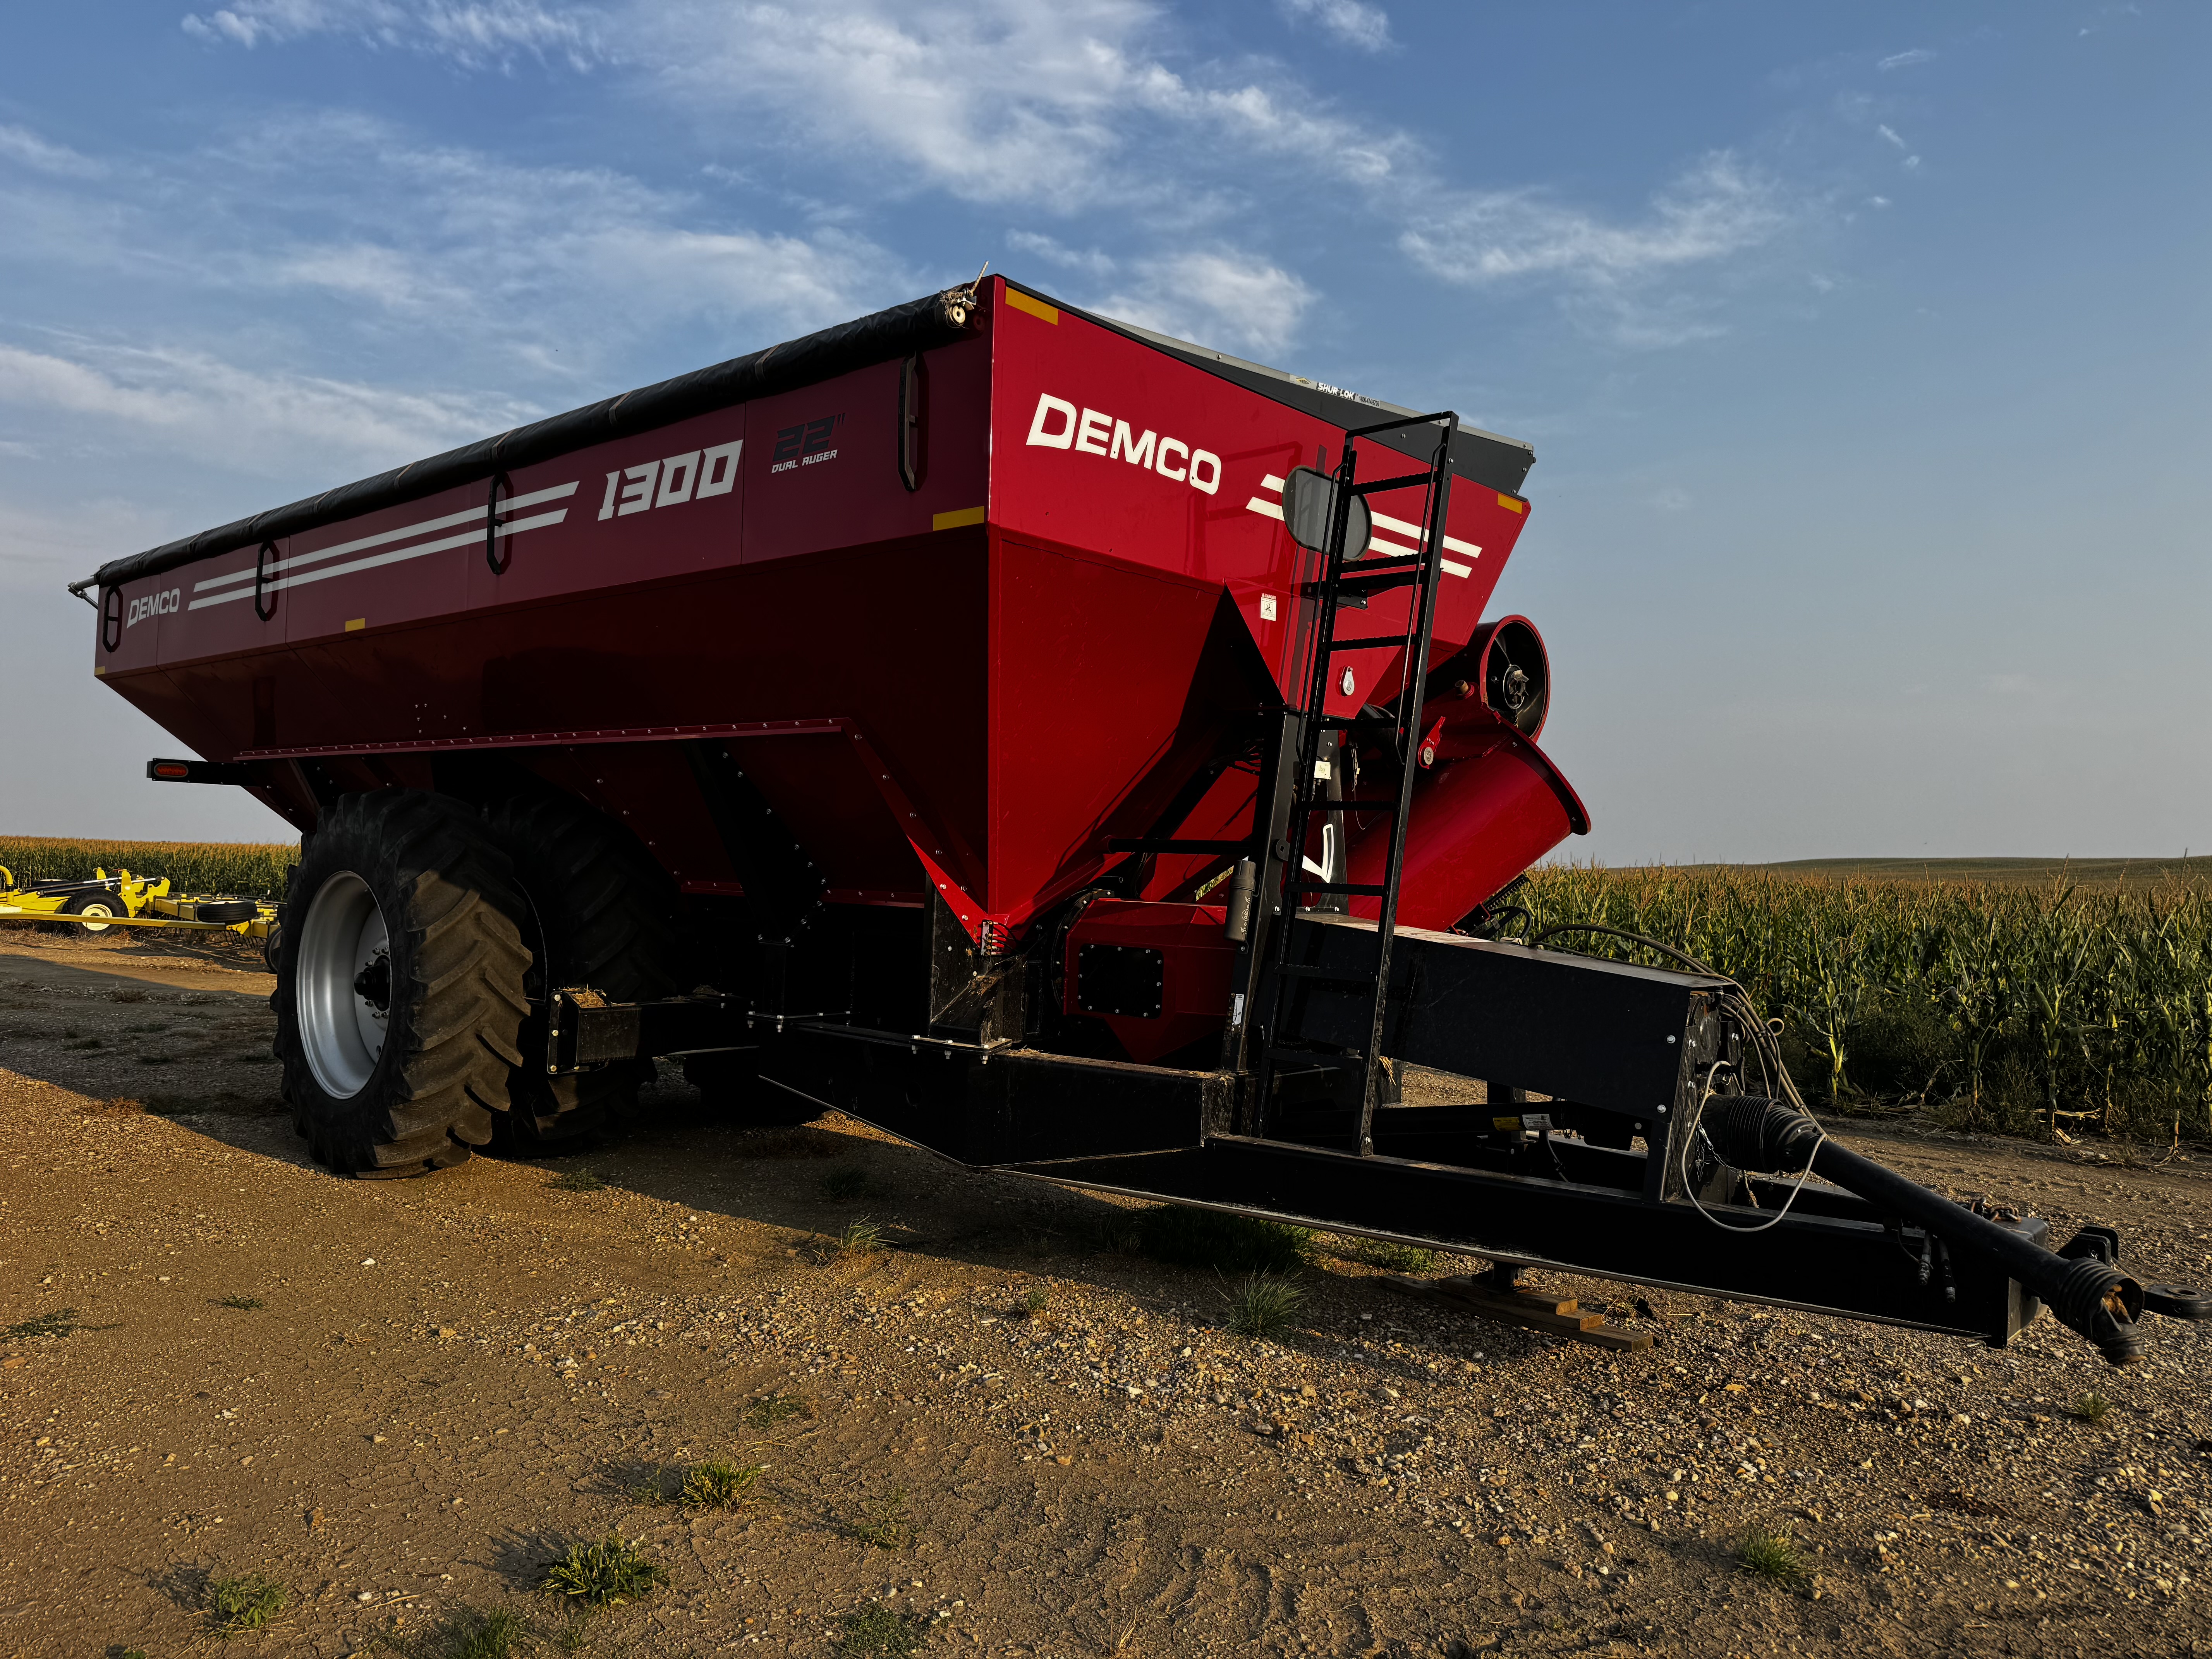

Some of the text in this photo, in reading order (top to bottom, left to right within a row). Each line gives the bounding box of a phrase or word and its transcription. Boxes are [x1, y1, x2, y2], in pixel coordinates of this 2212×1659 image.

[771, 449, 838, 474] DUAL AUGER
[1026, 392, 1222, 495] DEMCO
[598, 439, 744, 521] 1300
[126, 588, 180, 629] DEMCO
